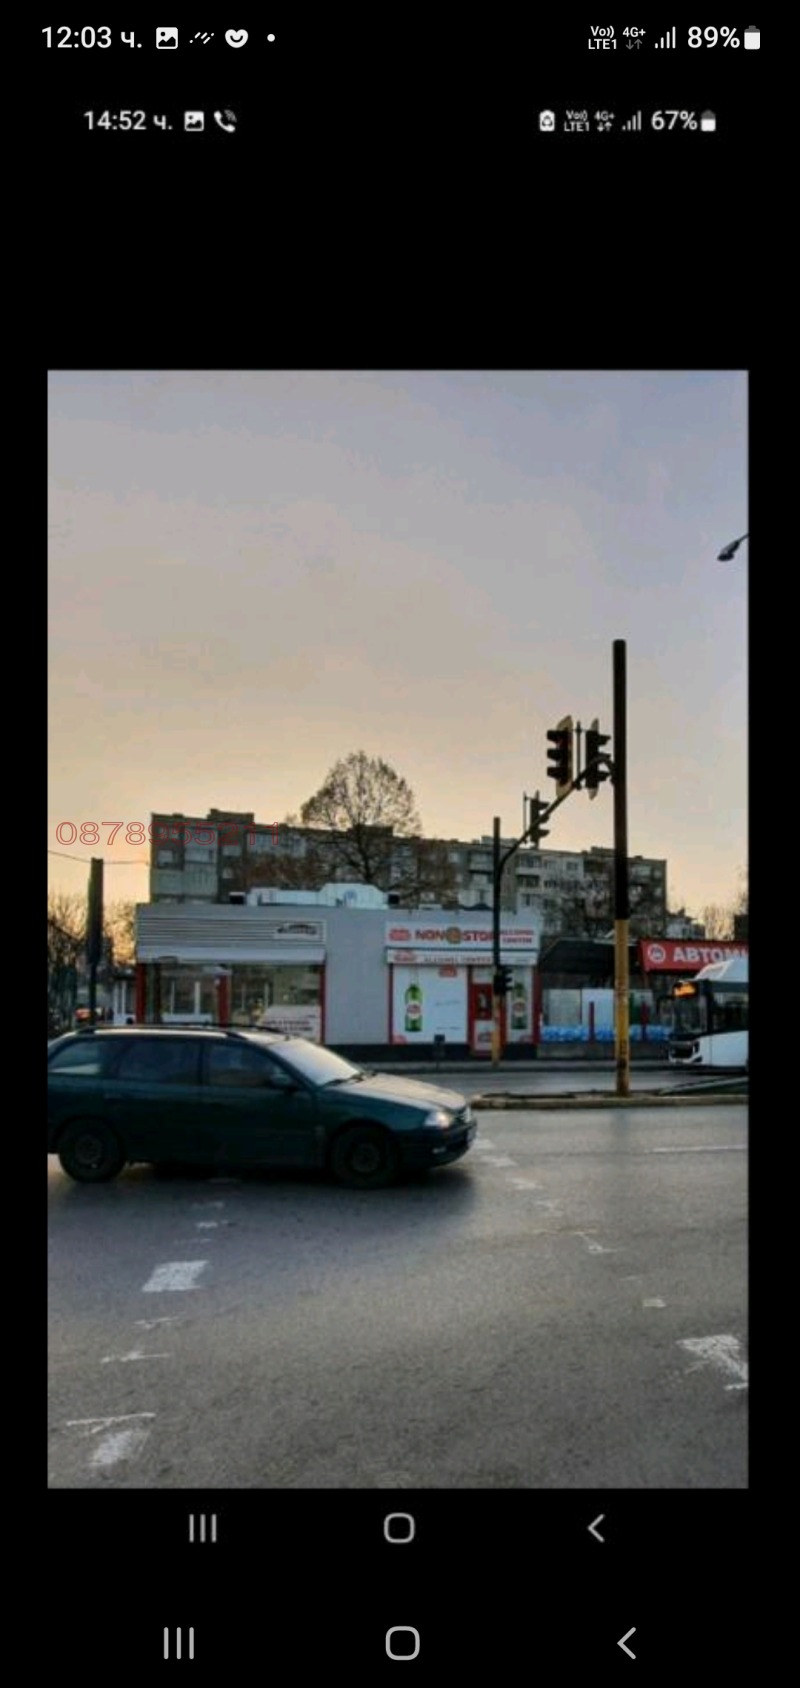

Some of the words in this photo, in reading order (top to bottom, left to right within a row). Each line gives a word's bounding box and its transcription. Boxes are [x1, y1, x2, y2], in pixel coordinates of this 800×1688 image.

[41, 26, 112, 49] 12:03
[120, 31, 142, 48] ч.
[622, 27, 646, 38] 4G+
[687, 26, 740, 49] 89%
[588, 39, 617, 50] LTE1
[83, 110, 147, 131] 14:52
[153, 114, 173, 131] ч.
[594, 110, 615, 121] 4G+
[651, 110, 698, 131] 67%
[564, 121, 590, 132] LTE1
[415, 929, 446, 942] NON
